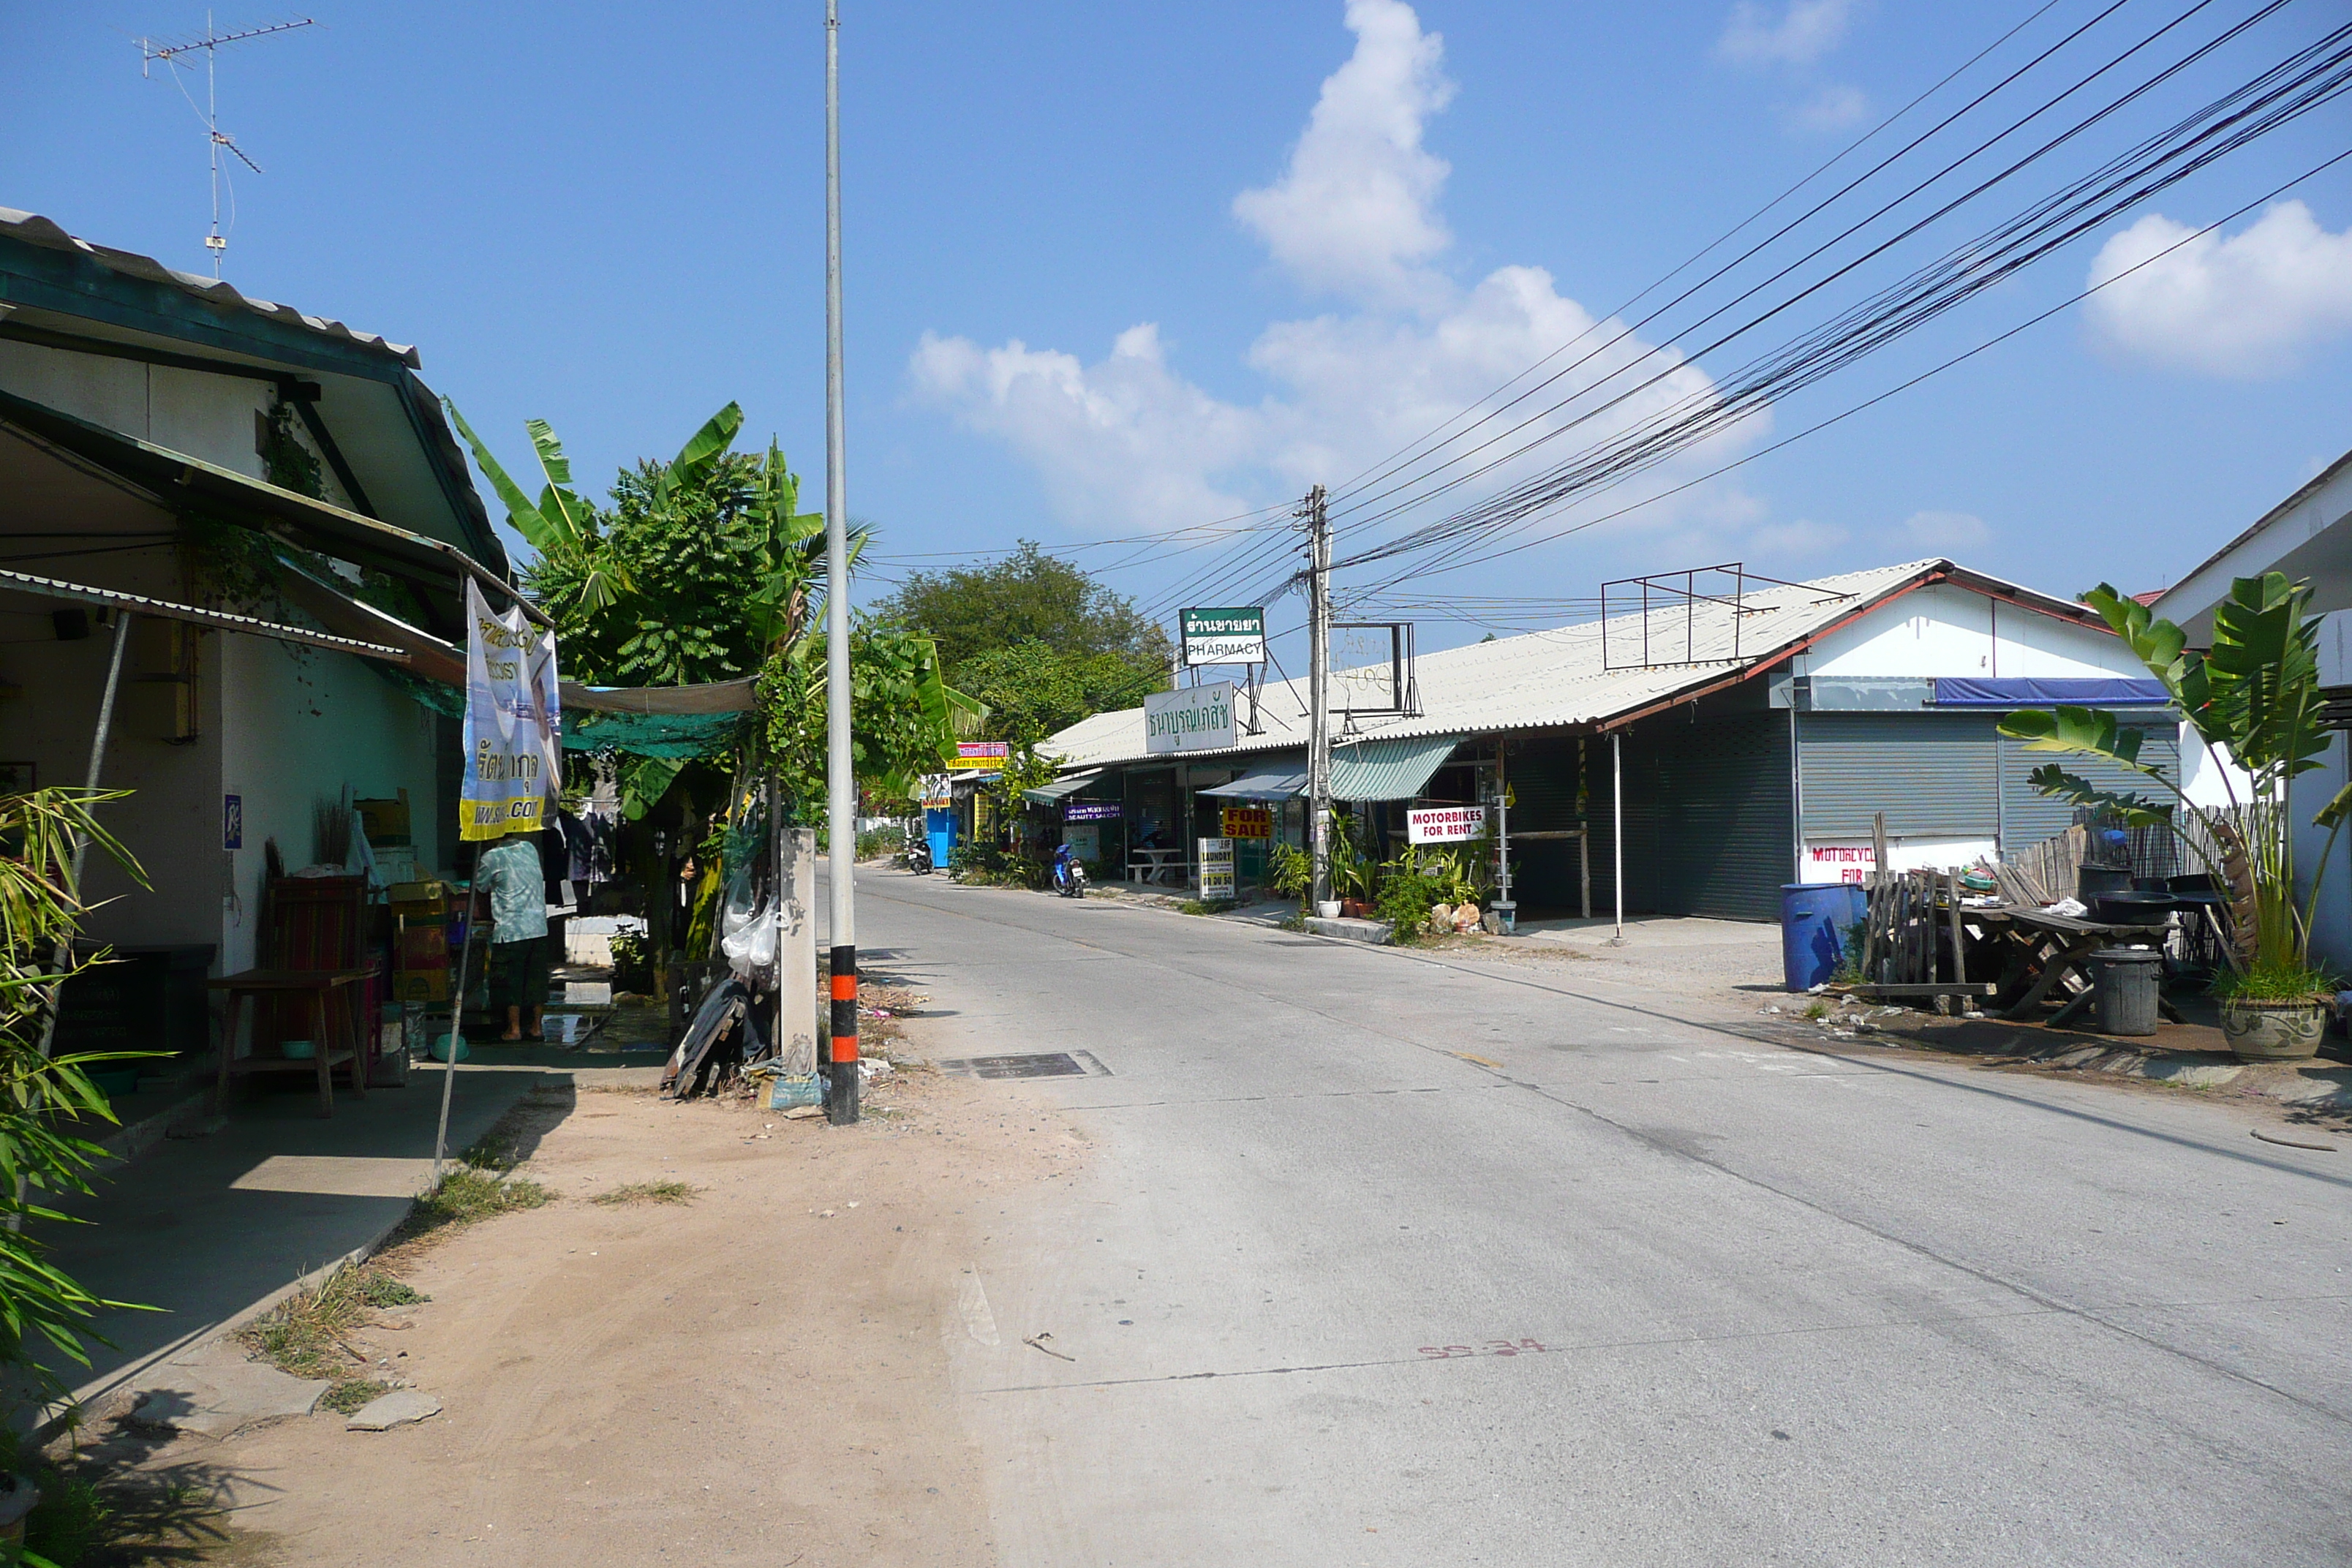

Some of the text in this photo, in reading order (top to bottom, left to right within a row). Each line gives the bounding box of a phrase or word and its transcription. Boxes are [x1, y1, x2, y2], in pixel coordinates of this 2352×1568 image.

[1187, 614, 1260, 633] ร้านขายยา
[1188, 643, 1262, 656] PHARMACY
[1227, 809, 1267, 823] FOR
[1412, 810, 1482, 825] MOTORBIKES
[1224, 823, 1270, 837] SALE
[1423, 823, 1472, 837] FOR RENT
[1202, 851, 1232, 862] LAUNDRY
[1812, 847, 1876, 862] MOTORCYCL
[1842, 868, 1863, 883] FOR
